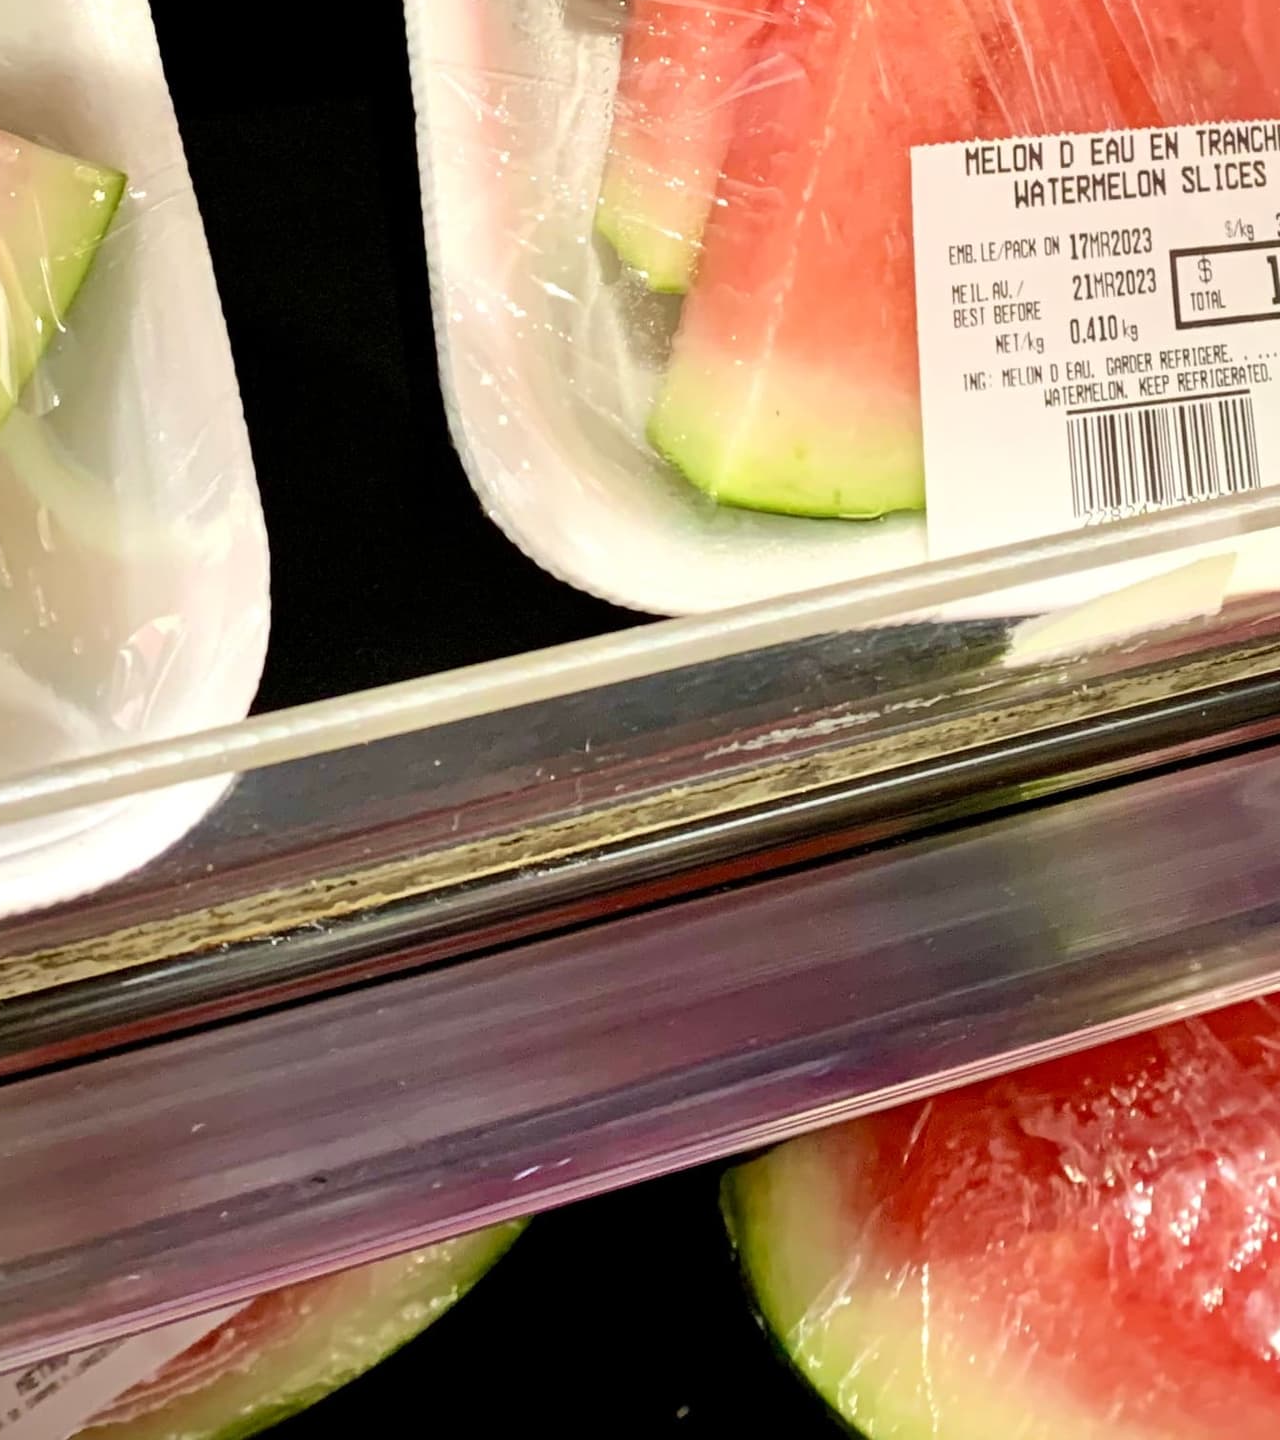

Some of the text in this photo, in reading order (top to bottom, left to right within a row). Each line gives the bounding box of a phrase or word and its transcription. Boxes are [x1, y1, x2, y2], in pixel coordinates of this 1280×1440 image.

[964, 141, 1043, 176] MELON
[1059, 140, 1075, 170] D
[1091, 135, 1135, 167] EAU
[1150, 131, 1179, 161] EN
[1014, 161, 1268, 210] WATERMELON SLICES
[1044, 232, 1061, 256] ON
[1068, 227, 1153, 261] 17MR2023
[1072, 268, 1157, 302] 21MR2023
[1190, 289, 1227, 313] TOTAL
[953, 301, 1042, 329] BEST BEFORE
[996, 315, 1139, 355] NET/kg 0.410 kg
[1002, 363, 1044, 389] MELON
[1106, 351, 1154, 377] GARDER
[1139, 375, 1170, 398] KEEP
